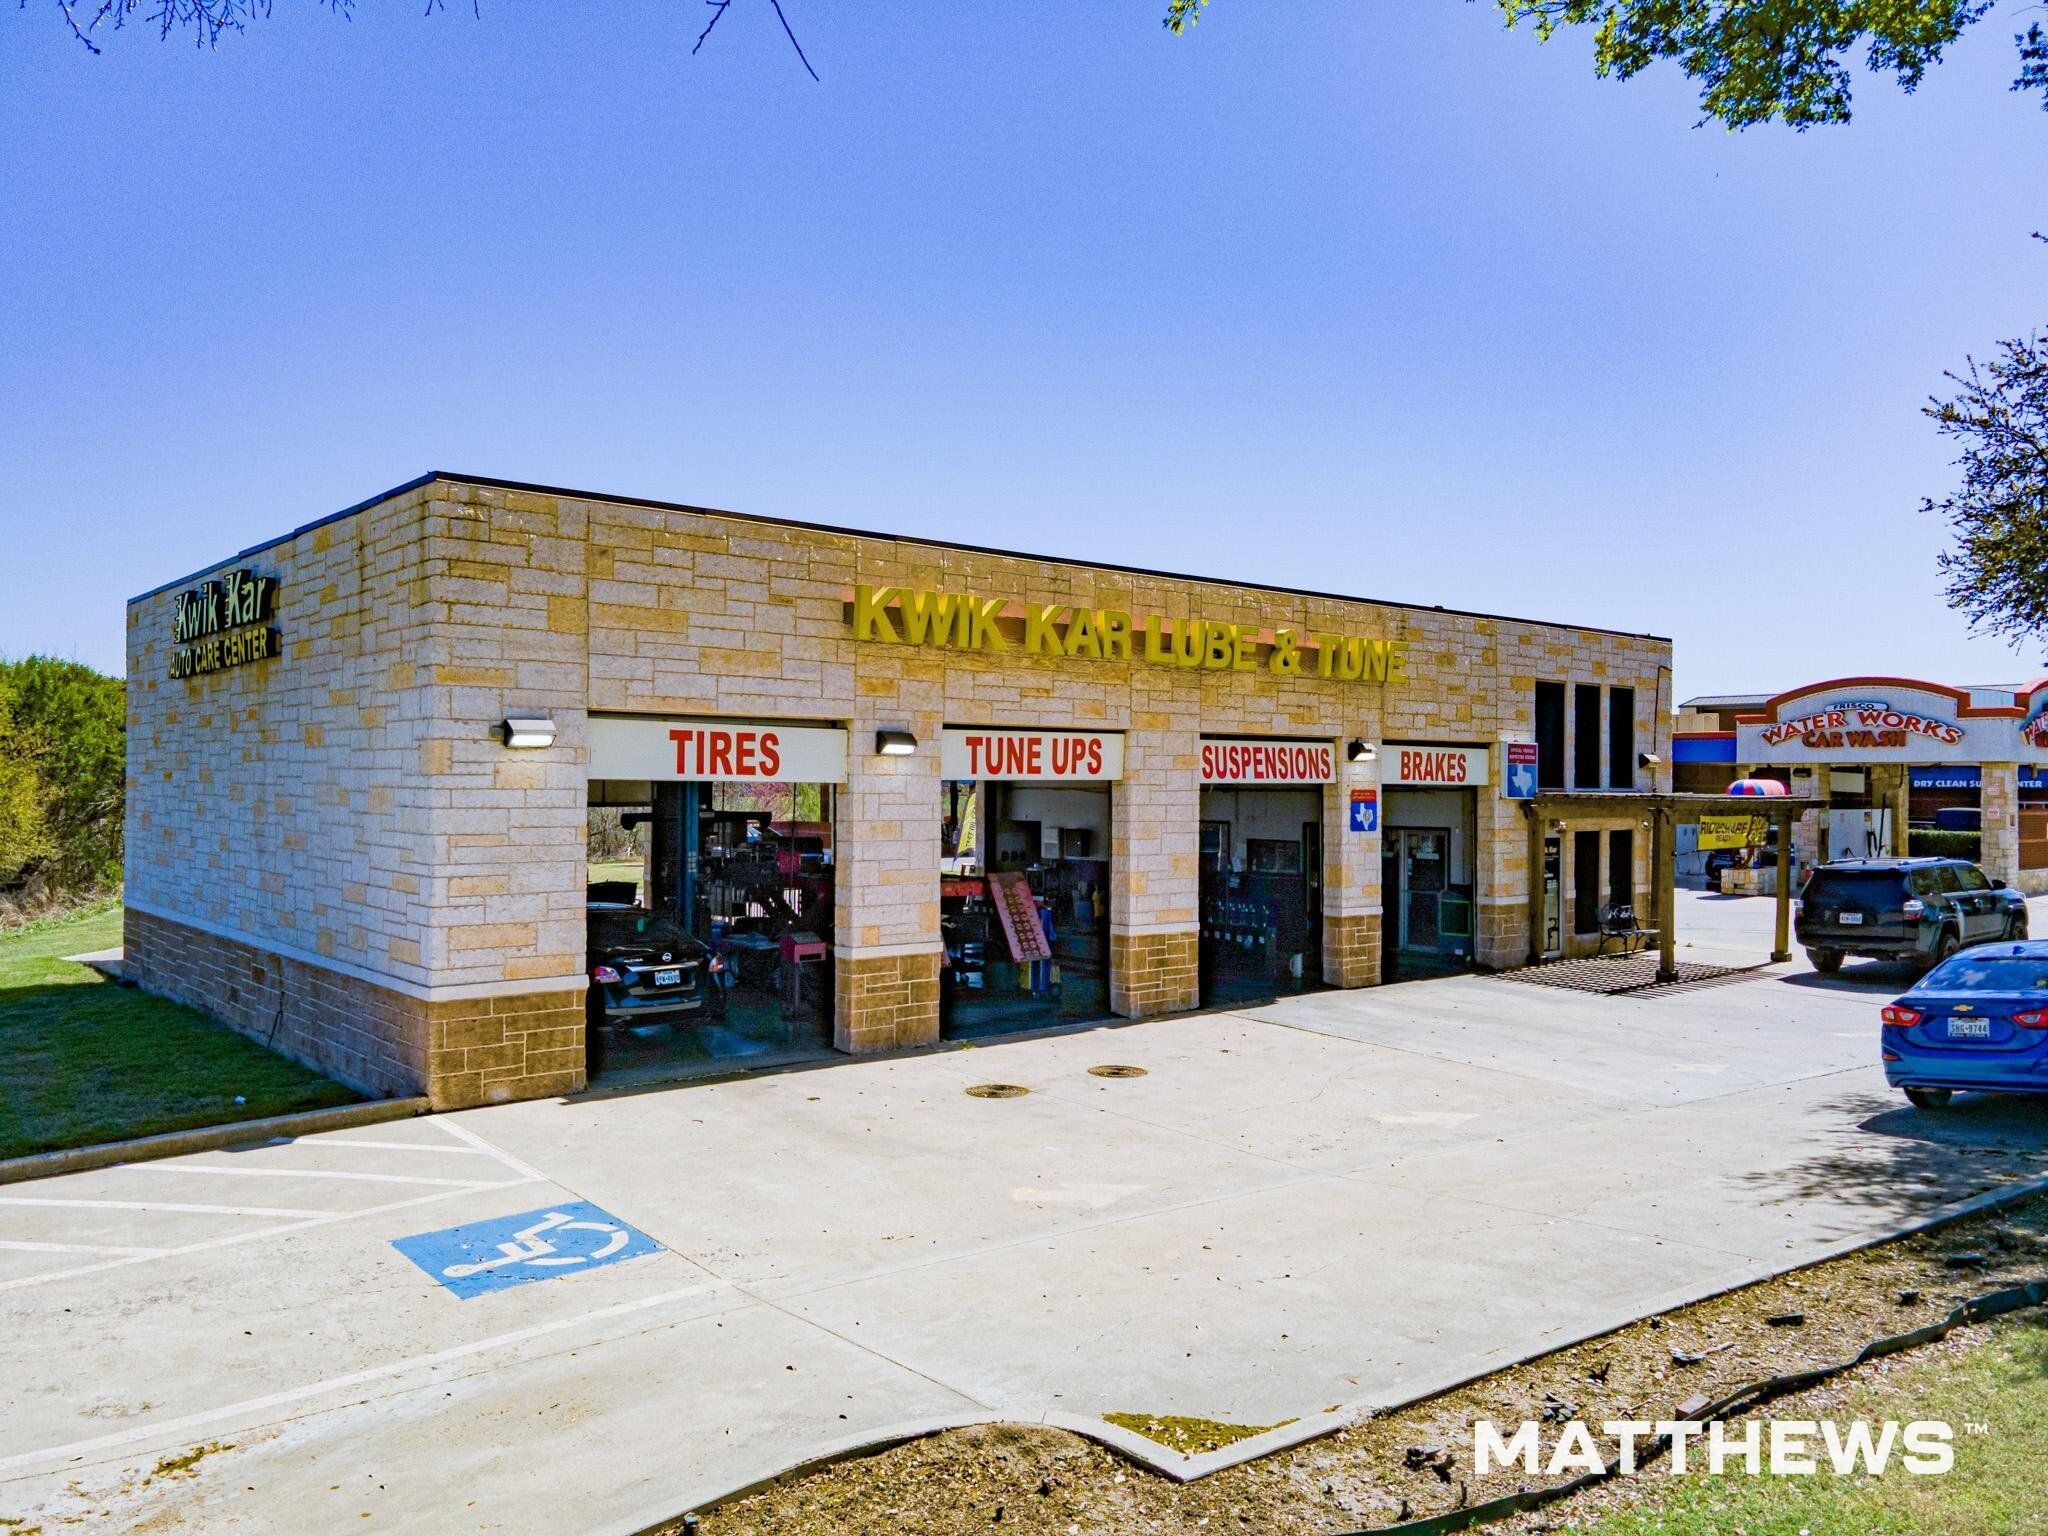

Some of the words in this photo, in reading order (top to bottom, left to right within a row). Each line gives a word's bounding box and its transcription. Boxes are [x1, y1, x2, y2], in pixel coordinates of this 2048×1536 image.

[174, 581, 219, 644] Kwik
[225, 570, 267, 629] Kar
[853, 583, 1008, 652] KWIK
[1025, 604, 1132, 659] KAR
[1145, 614, 1258, 671] LUBE
[1270, 629, 1300, 674] &
[1312, 633, 1409, 683] TUNE
[170, 649, 191, 679] AUTO
[196, 642, 220, 673] CARE
[224, 627, 267, 665] CENTER
[1833, 702, 1875, 710] FRISCO
[1761, 711, 1847, 746] WATER
[1857, 709, 1963, 745] WORKS
[1802, 730, 1844, 748] CAR
[1846, 731, 1908, 748] WASH
[669, 729, 780, 776] TIRES
[965, 736, 1042, 775] TUNE
[1052, 737, 1102, 775] UPS
[1202, 745, 1331, 780] SUSPENSIONS
[1400, 751, 1467, 783] BRAKES
[1914, 780, 1933, 788] DRY
[1935, 780, 1967, 788] CLEAN
